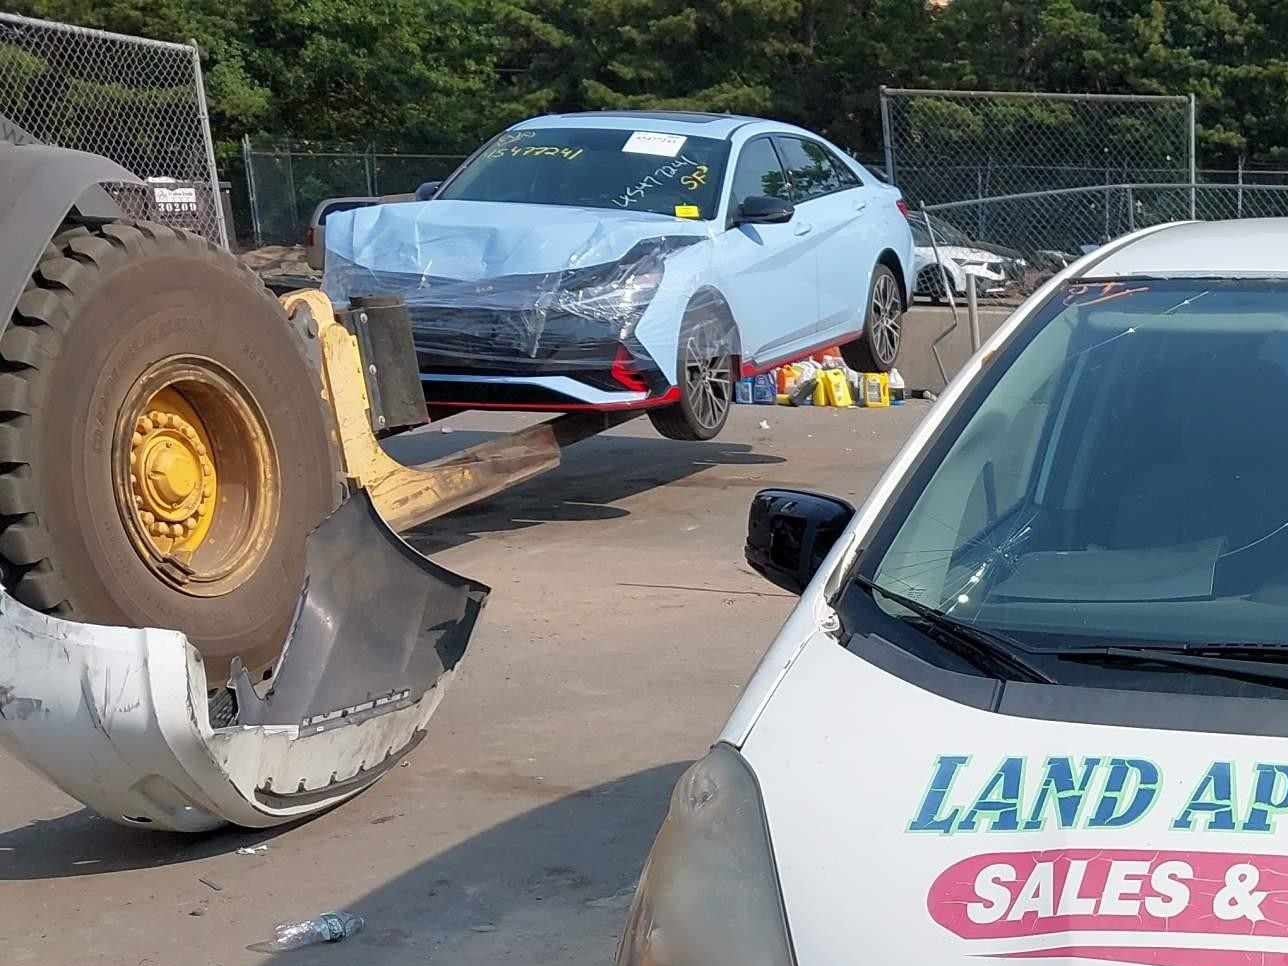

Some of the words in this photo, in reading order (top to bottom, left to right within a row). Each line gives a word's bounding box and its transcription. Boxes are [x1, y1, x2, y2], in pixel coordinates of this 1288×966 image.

[905, 754, 1164, 836] LAND
[966, 860, 1195, 924] SALES
[1213, 863, 1270, 922] &
